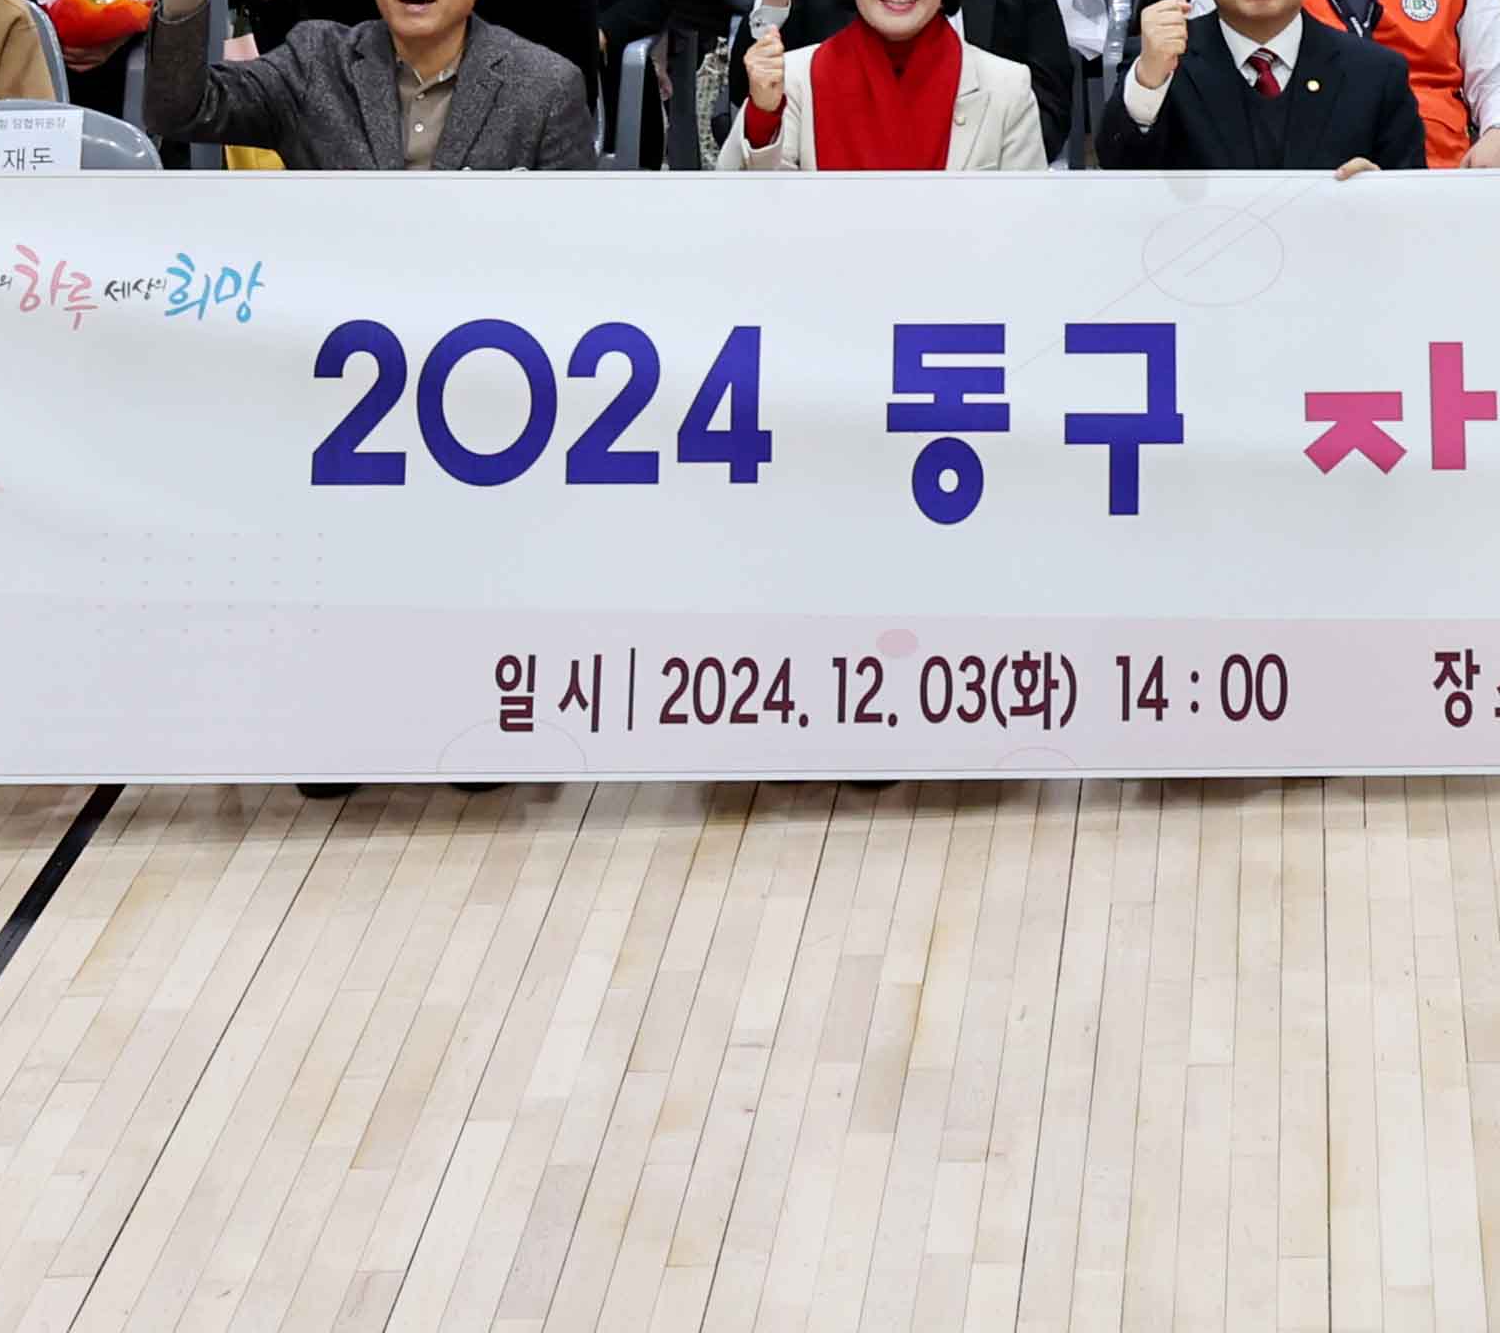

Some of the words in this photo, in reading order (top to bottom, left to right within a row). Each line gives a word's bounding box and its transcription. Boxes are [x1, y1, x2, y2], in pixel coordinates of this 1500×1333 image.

[13, 243, 99, 331] 하루
[164, 251, 266, 324] 희망
[312, 319, 771, 487] 2024
[887, 323, 1184, 525] 동구
[659, 656, 809, 728] 2024.
[832, 655, 898, 728] 12.
[919, 650, 1077, 731] 03(화)
